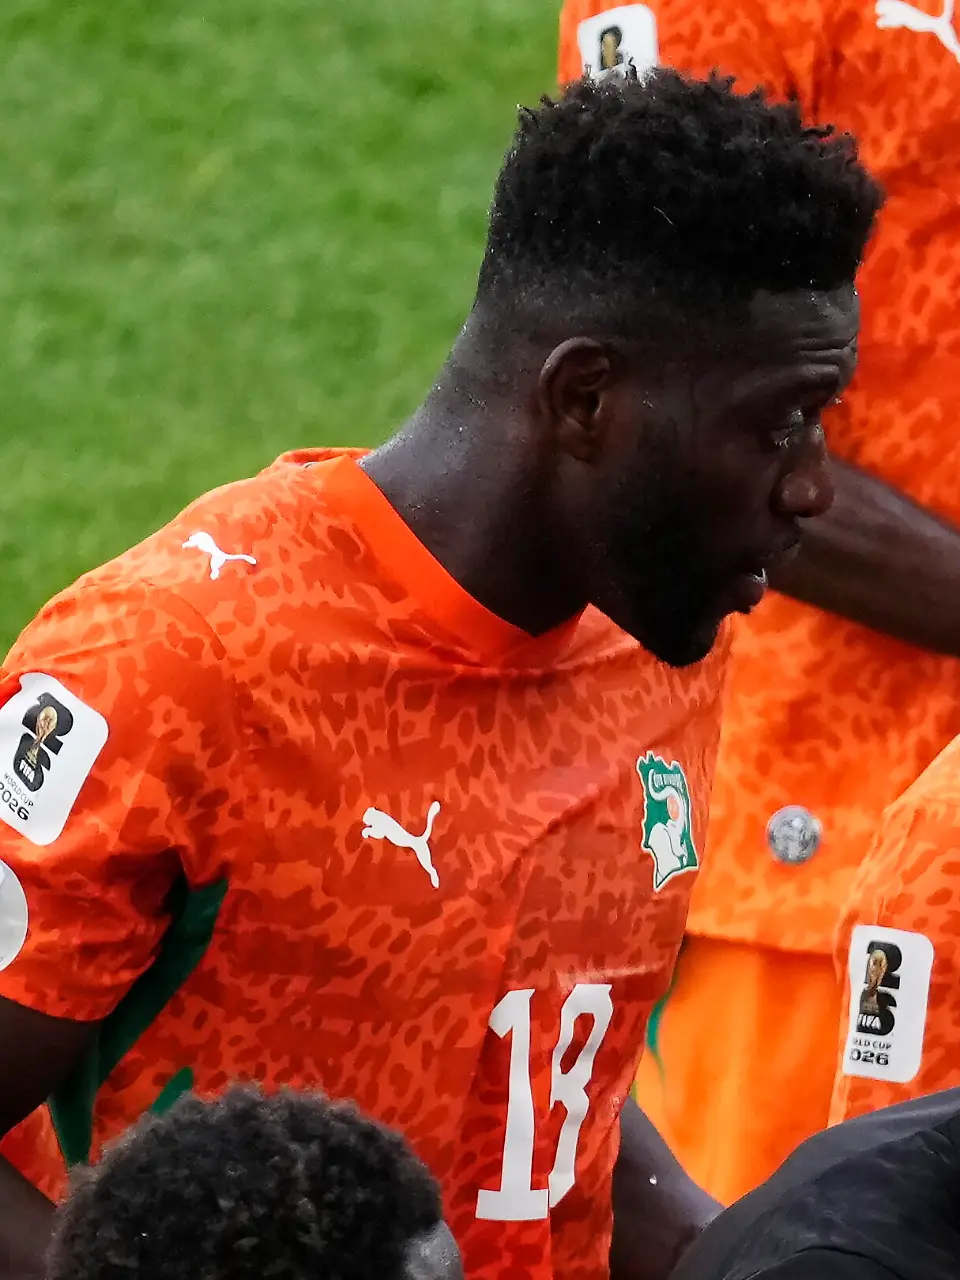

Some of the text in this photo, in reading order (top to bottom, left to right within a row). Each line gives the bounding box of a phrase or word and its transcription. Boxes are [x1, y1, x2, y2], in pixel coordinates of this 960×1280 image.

[19, 759, 35, 783] FIFA
[4, 772, 34, 807] WORLD CUP
